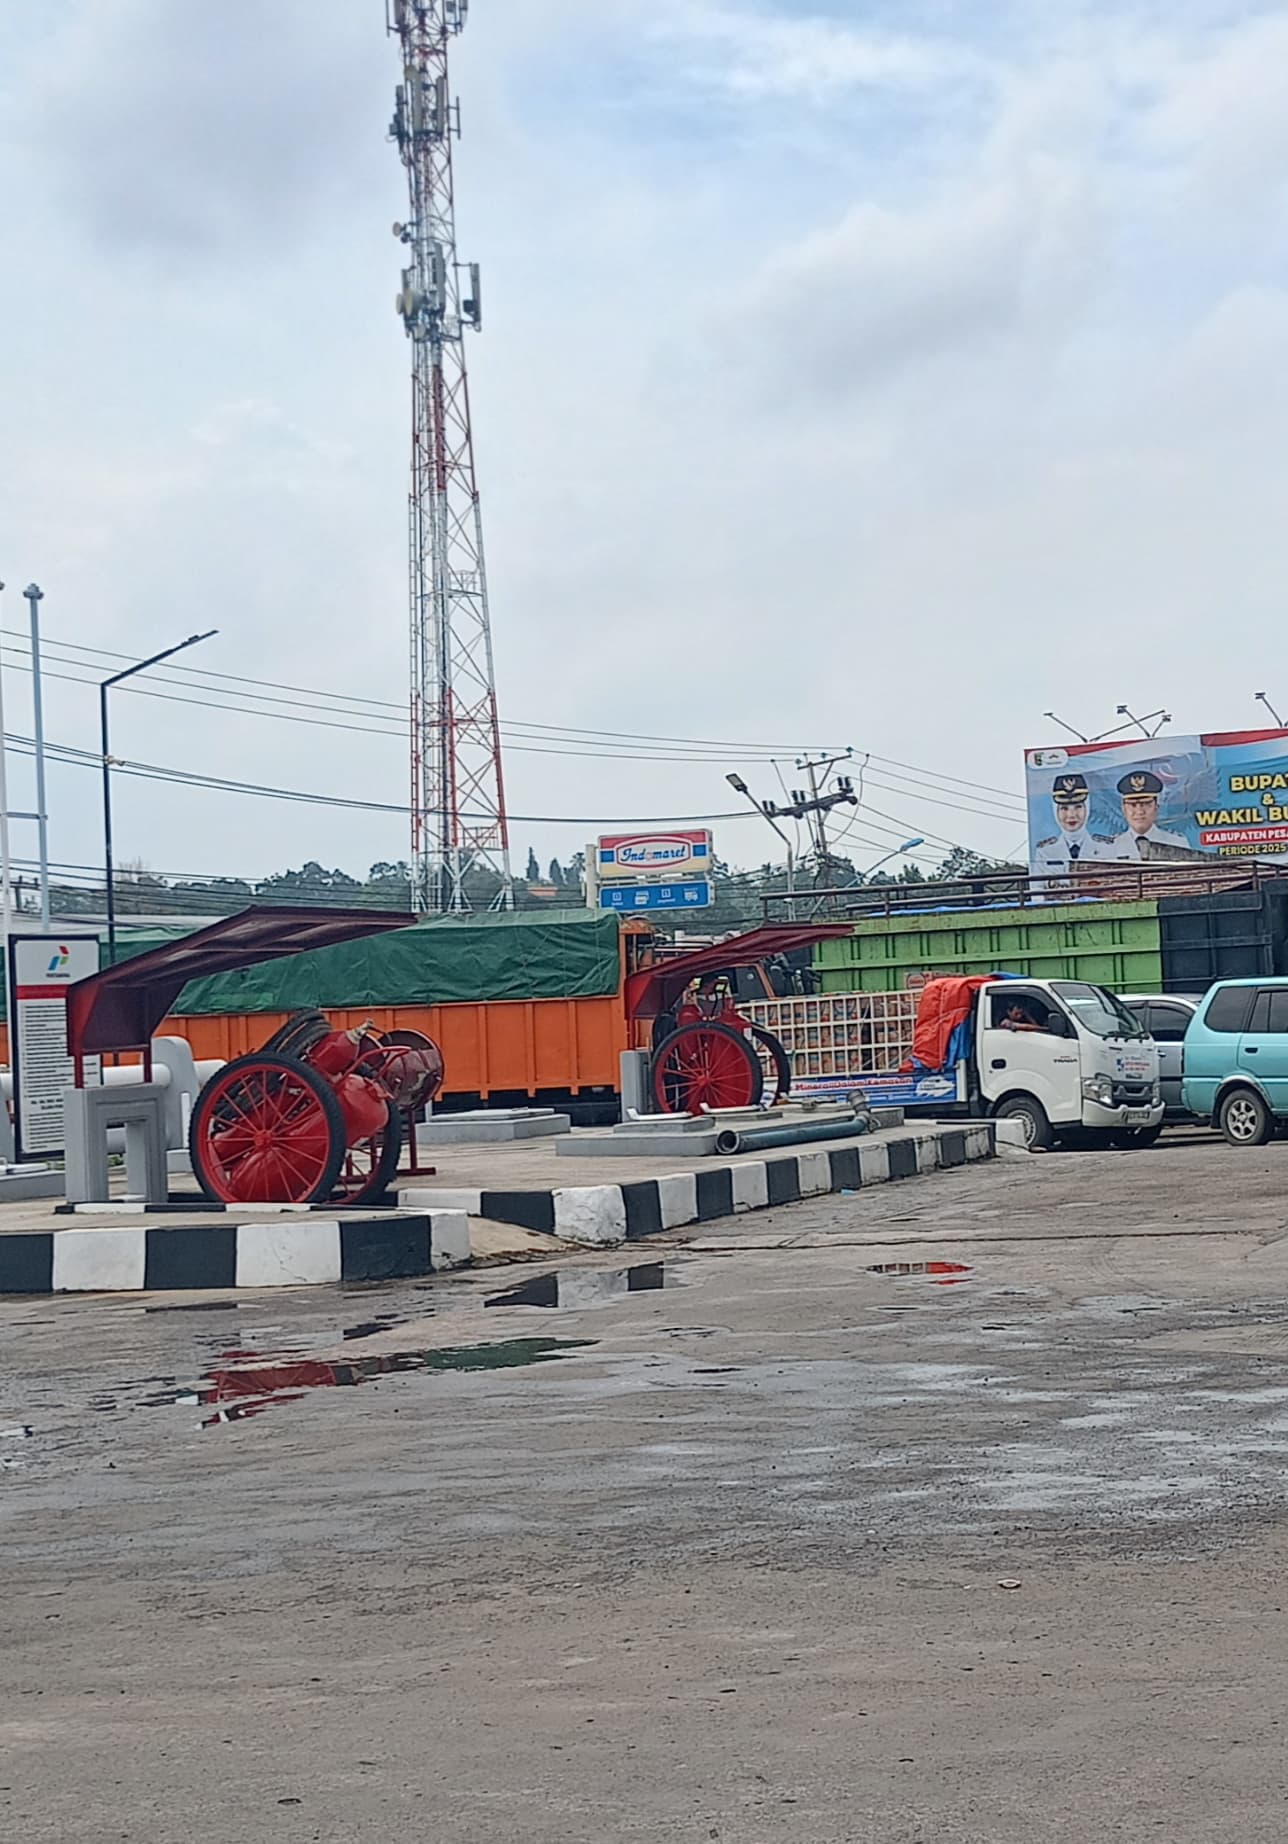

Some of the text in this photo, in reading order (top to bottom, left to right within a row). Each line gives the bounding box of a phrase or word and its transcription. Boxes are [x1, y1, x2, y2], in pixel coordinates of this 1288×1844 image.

[1262, 792, 1275, 806] &
[1196, 808, 1263, 826] WAKIL
[1206, 830, 1266, 843] KABUPATEN
[620, 845, 686, 862] Indomaret
[1219, 844, 1259, 856] PERIODE
[1263, 843, 1286, 854] 2025
